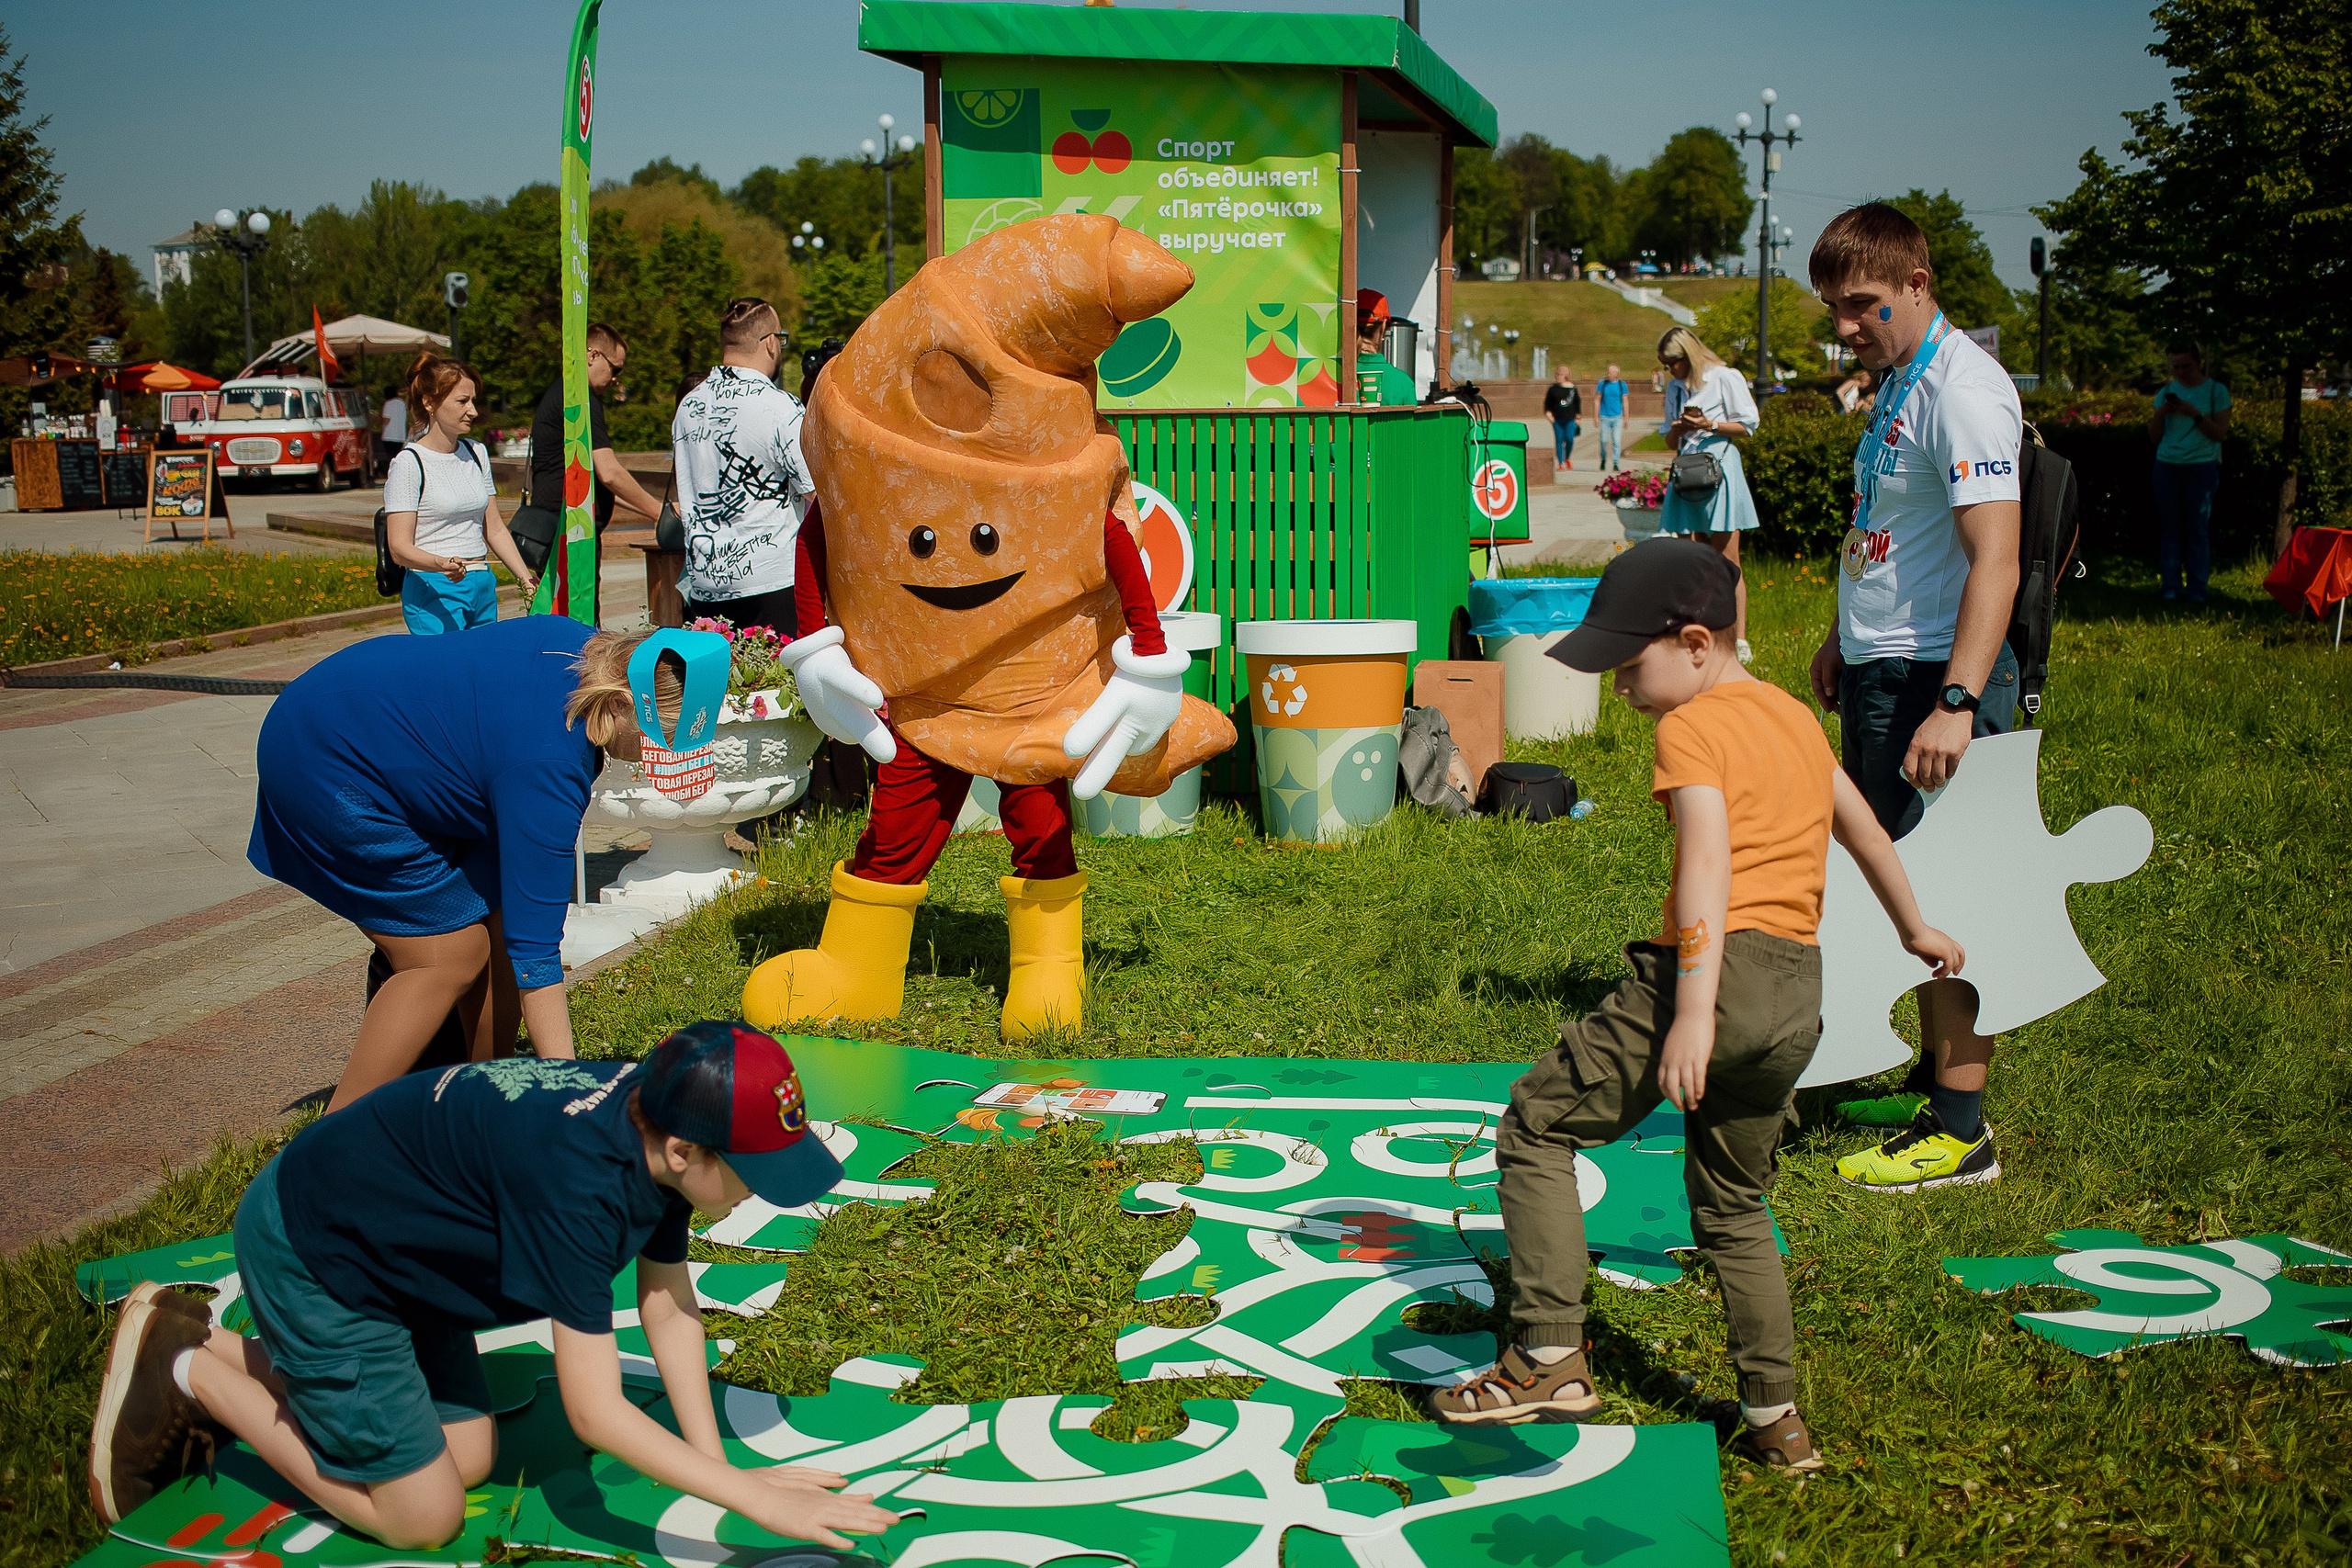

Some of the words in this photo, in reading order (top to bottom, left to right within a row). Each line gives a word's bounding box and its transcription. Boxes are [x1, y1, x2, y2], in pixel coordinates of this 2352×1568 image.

[1157, 138, 1235, 162] Спорт
[1158, 166, 1318, 188] объединяет!
[1158, 196, 1323, 223] «Пятёрочка»
[1159, 231, 1286, 254] выручает
[1909, 363, 1923, 380] ПСБ
[1974, 460, 2012, 477] ПСБ
[644, 705, 652, 723] ПСБ
[642, 750, 684, 763] БЕГОВАЯ
[692, 783, 706, 797] БЕГ
